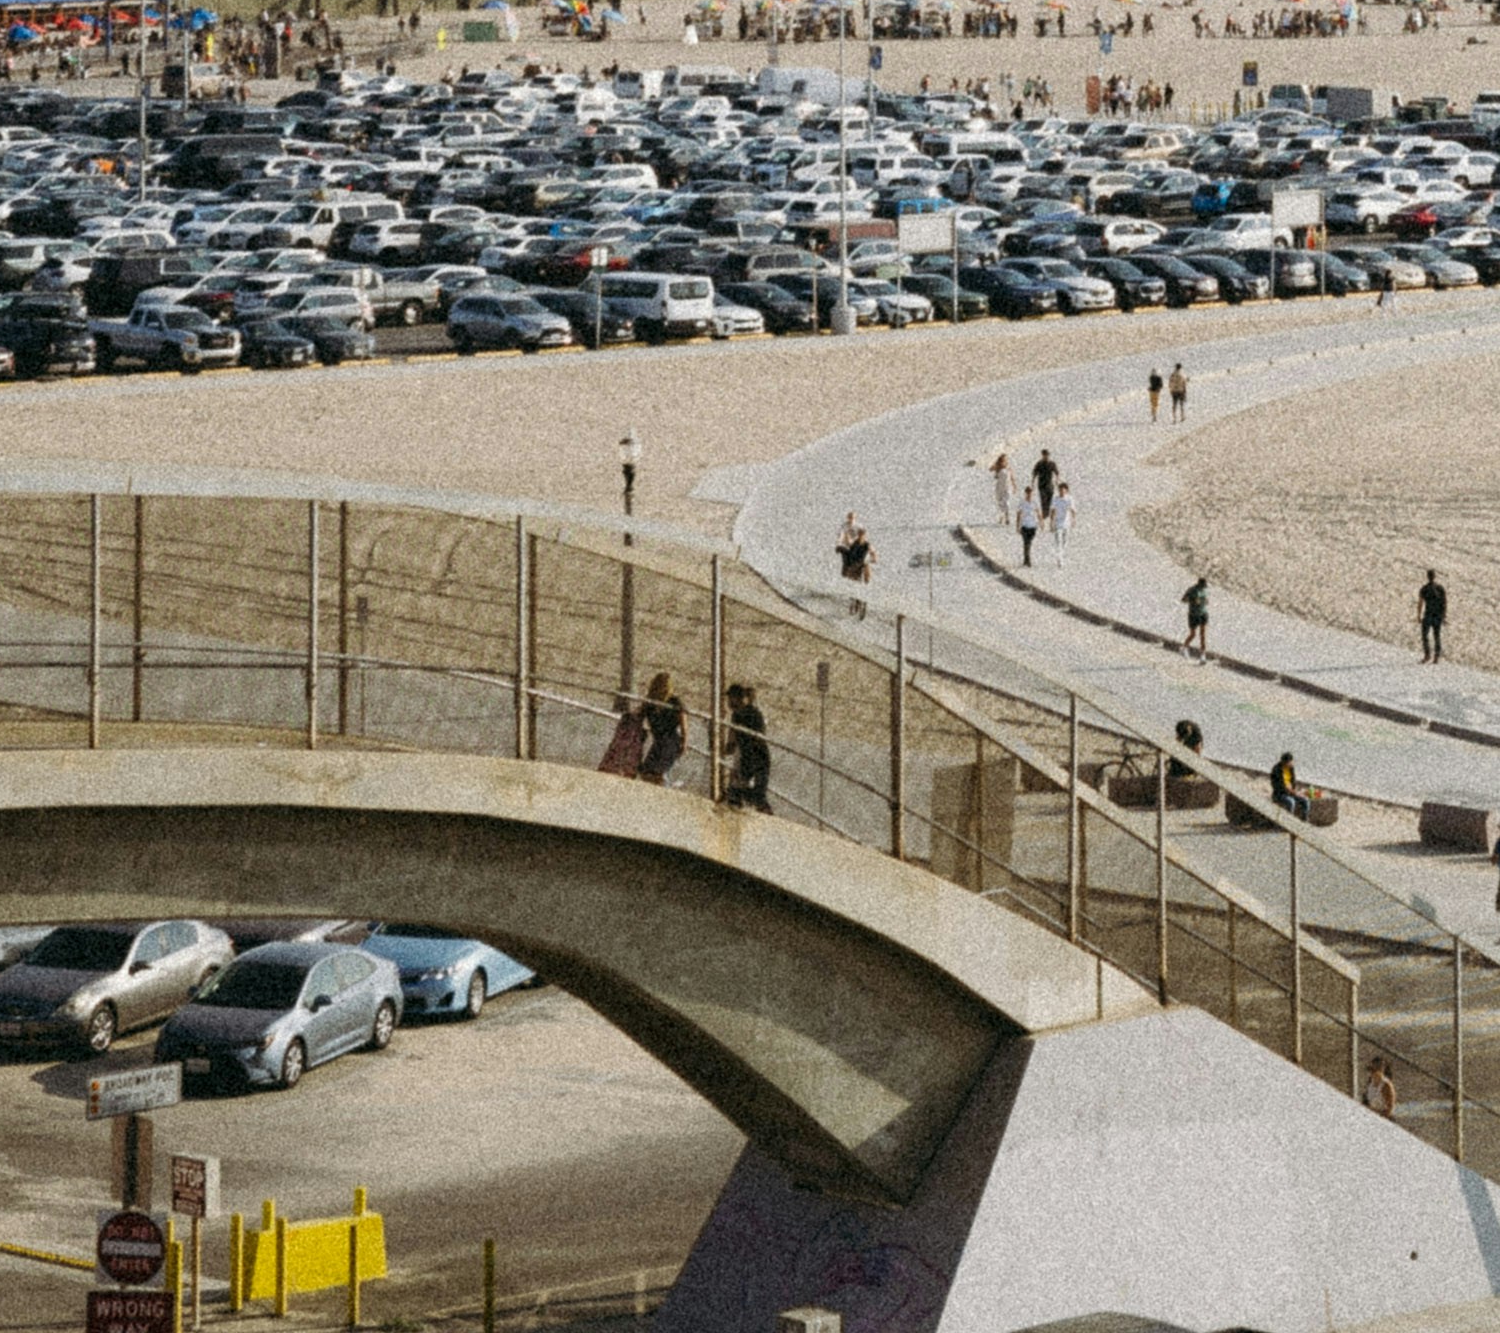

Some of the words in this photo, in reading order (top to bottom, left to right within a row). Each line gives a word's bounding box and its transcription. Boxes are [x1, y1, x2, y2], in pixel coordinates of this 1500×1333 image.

[174, 1166, 204, 1189] STOP
[107, 1224, 123, 1238] DO
[131, 1225, 155, 1239] NOT
[110, 1257, 150, 1272] ENTER
[97, 1299, 165, 1318] WRONG
[108, 1322, 150, 1333] WAY
